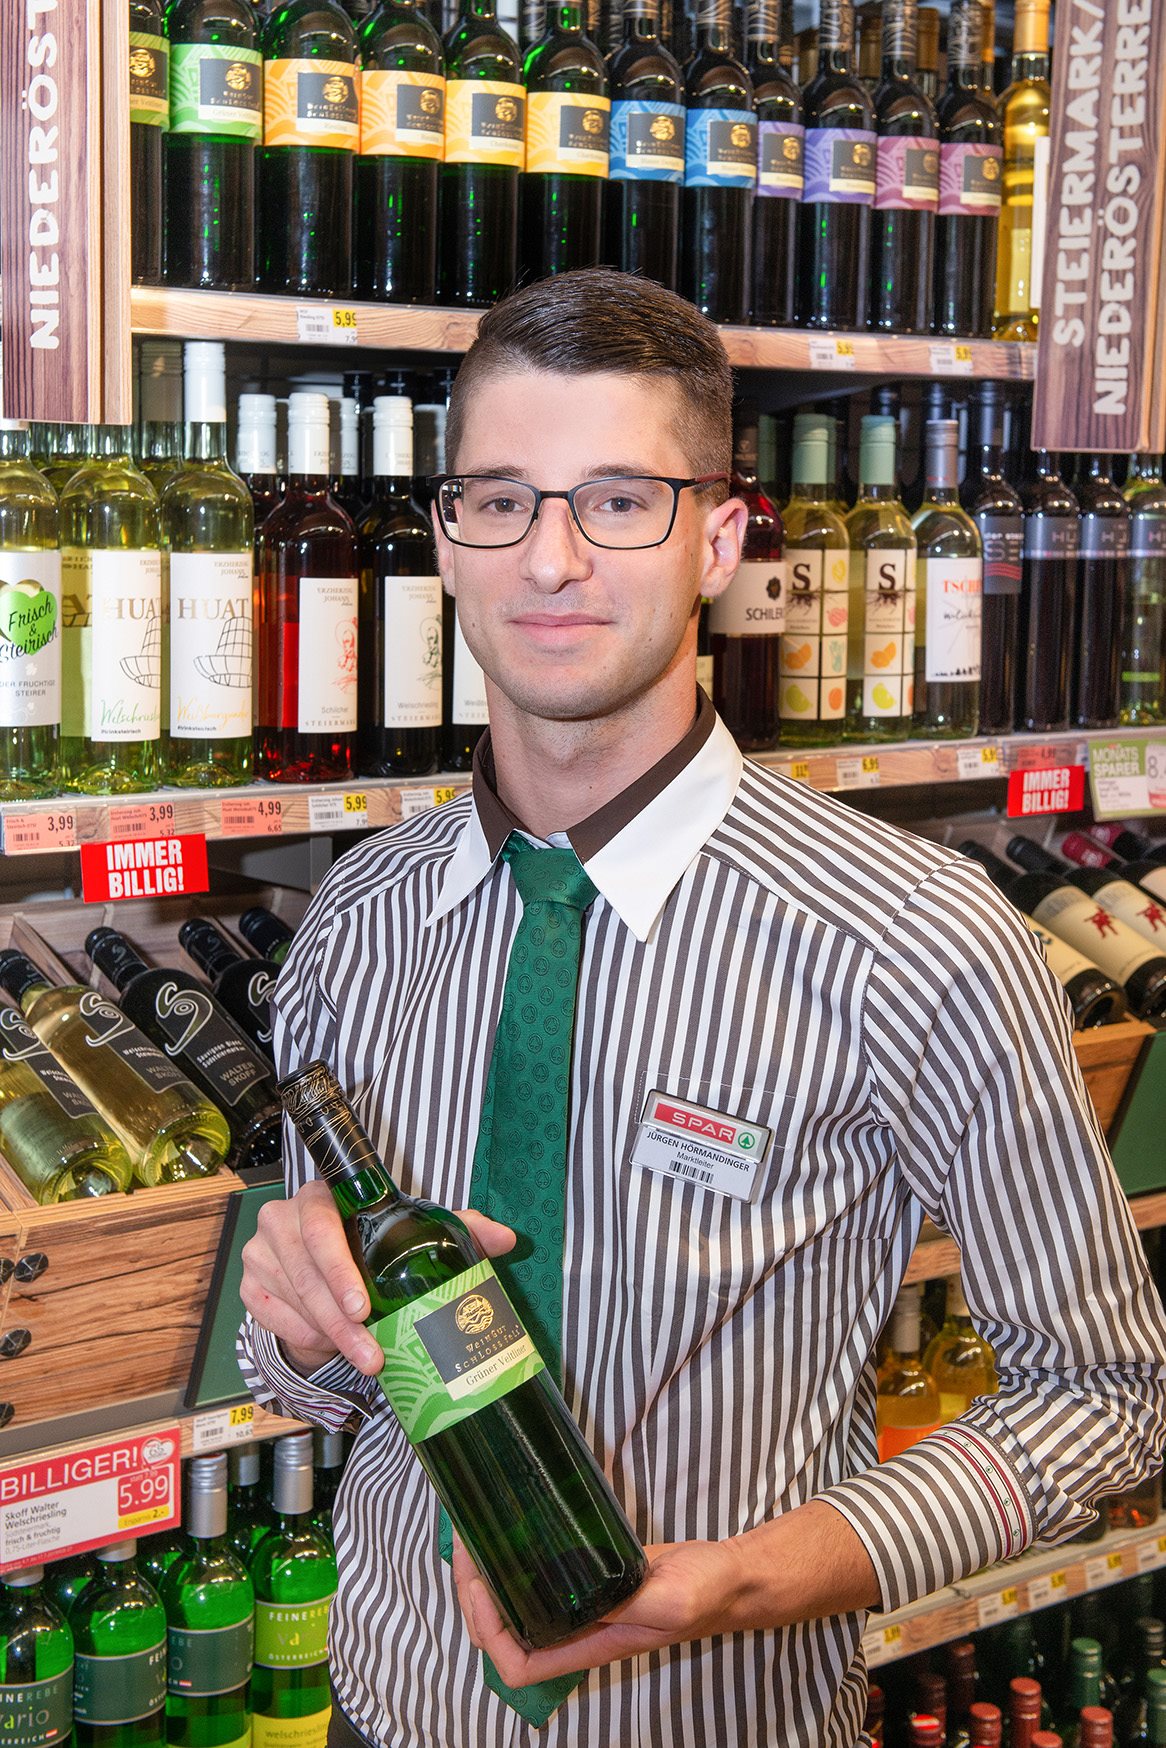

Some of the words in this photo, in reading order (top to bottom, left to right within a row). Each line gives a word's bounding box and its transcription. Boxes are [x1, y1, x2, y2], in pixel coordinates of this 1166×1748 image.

[8, 595, 53, 632] Frisch
[28, 622, 37, 637] &
[0, 624, 59, 663] Steirisch
[15, 689, 46, 697] STEIRER
[18, 680, 56, 688] FRUCHTIGE
[1094, 761, 1140, 777] SPARER
[1023, 768, 1071, 792] IMMER
[257, 801, 282, 818] 4,99
[1022, 789, 1070, 814] BILLIG!
[149, 804, 174, 823] 3,99
[47, 815, 74, 834] 3,99
[106, 840, 183, 871] IMMER
[108, 867, 184, 898] BILLIG!
[220, 1061, 256, 1082] WALTER
[228, 1069, 257, 1087] SKOFF
[671, 1111, 735, 1142] SPAR
[647, 1131, 680, 1149] JÜRGEN
[680, 1143, 751, 1173] HÖRMANDINGER
[676, 1151, 715, 1170] Marktleiter
[466, 1361, 498, 1386] Grüner
[499, 1344, 526, 1366] Veltliner
[231, 1405, 254, 1425] 7,99
[1, 1446, 138, 1500] BILLIGER!
[119, 1475, 169, 1509] 5.99
[4, 1508, 68, 1531] Welschriesling
[5, 1507, 29, 1520] Skoff
[30, 1501, 60, 1515] Walter
[5, 1535, 25, 1547] frisch
[26, 1533, 32, 1541] &
[33, 1526, 61, 1538] fruchtig
